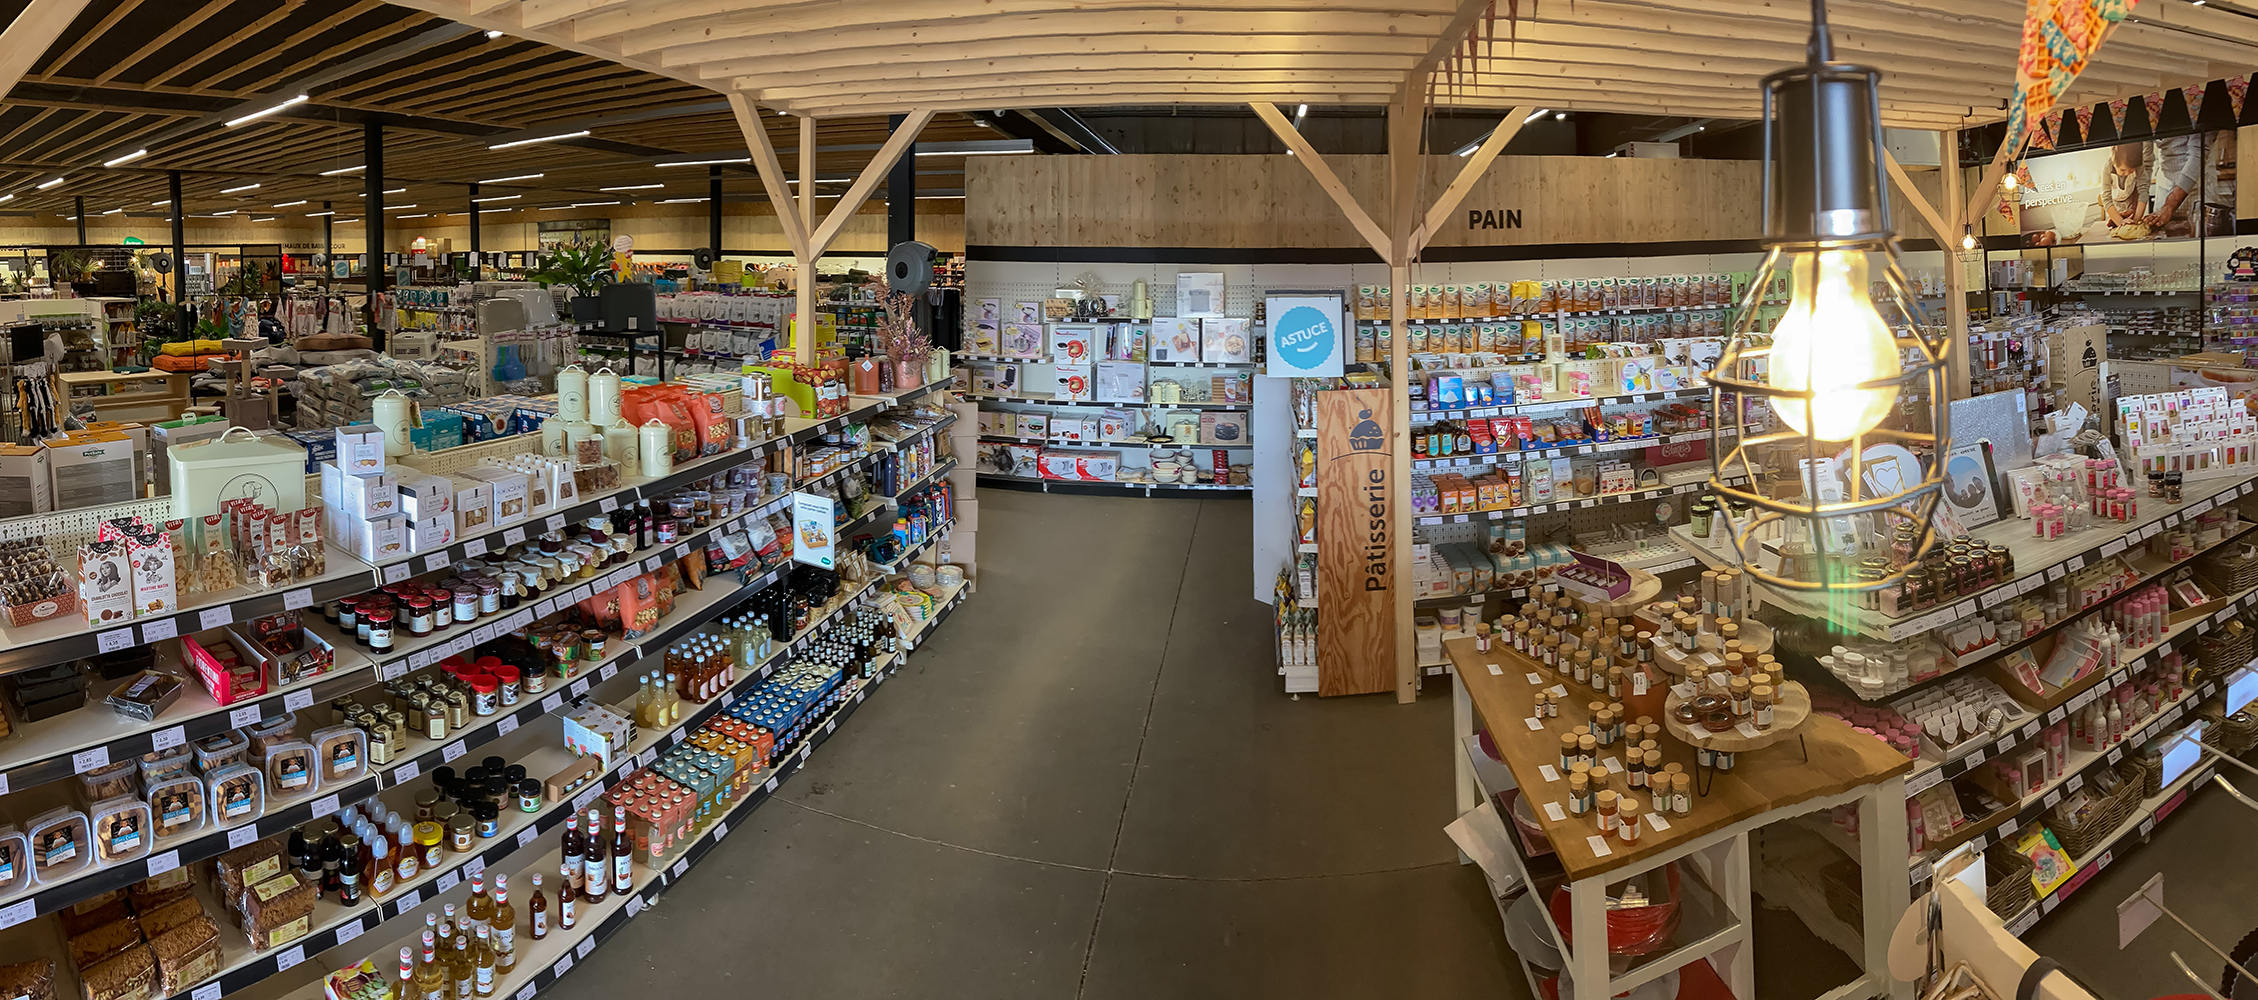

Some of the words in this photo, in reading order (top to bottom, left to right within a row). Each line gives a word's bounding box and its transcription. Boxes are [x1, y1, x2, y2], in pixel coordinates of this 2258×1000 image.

[2056, 181, 2067, 190] en
[1469, 209, 1522, 230] PAIN
[1280, 321, 1329, 349] ASTUCE
[252, 509, 268, 519] VITAL
[303, 507, 316, 517] VITAL
[205, 515, 222, 524] VITAL
[273, 514, 288, 523] VITAL
[167, 519, 184, 530] VITAL
[1365, 469, 1387, 592] Pâtisserie
[156, 583, 169, 591] MATIN
[111, 590, 129, 598] CHOCOLAT
